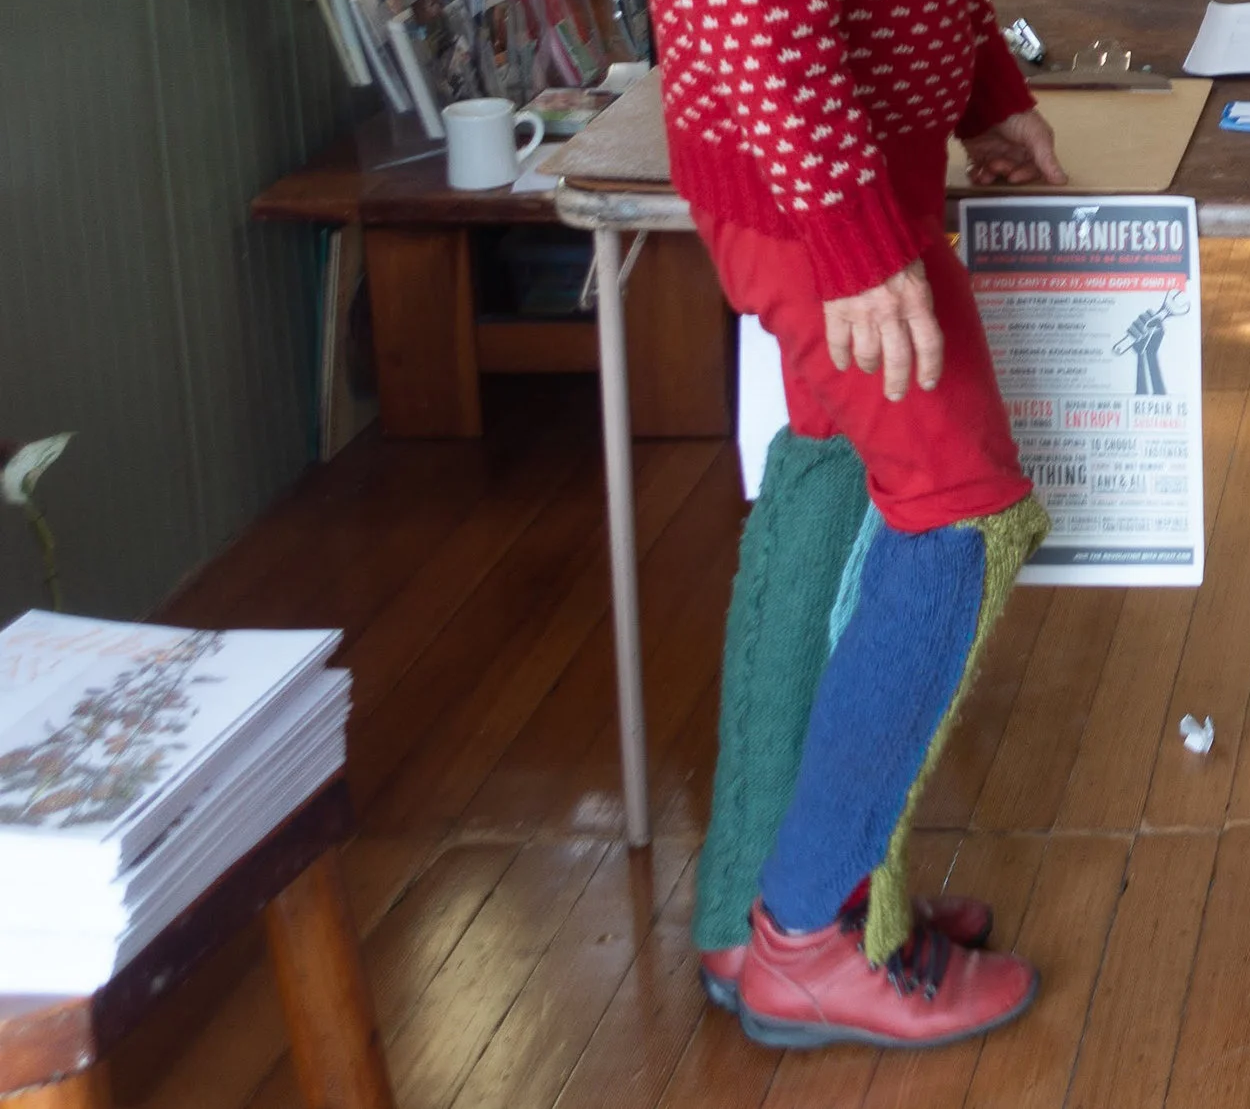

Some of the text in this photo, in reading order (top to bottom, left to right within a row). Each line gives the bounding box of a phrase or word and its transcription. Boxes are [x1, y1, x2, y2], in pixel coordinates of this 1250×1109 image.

[974, 220, 1185, 252] REPAIR MANIFESTO
[1134, 401, 1172, 416] REPAIR
[1064, 410, 1121, 428] ENTROPY
